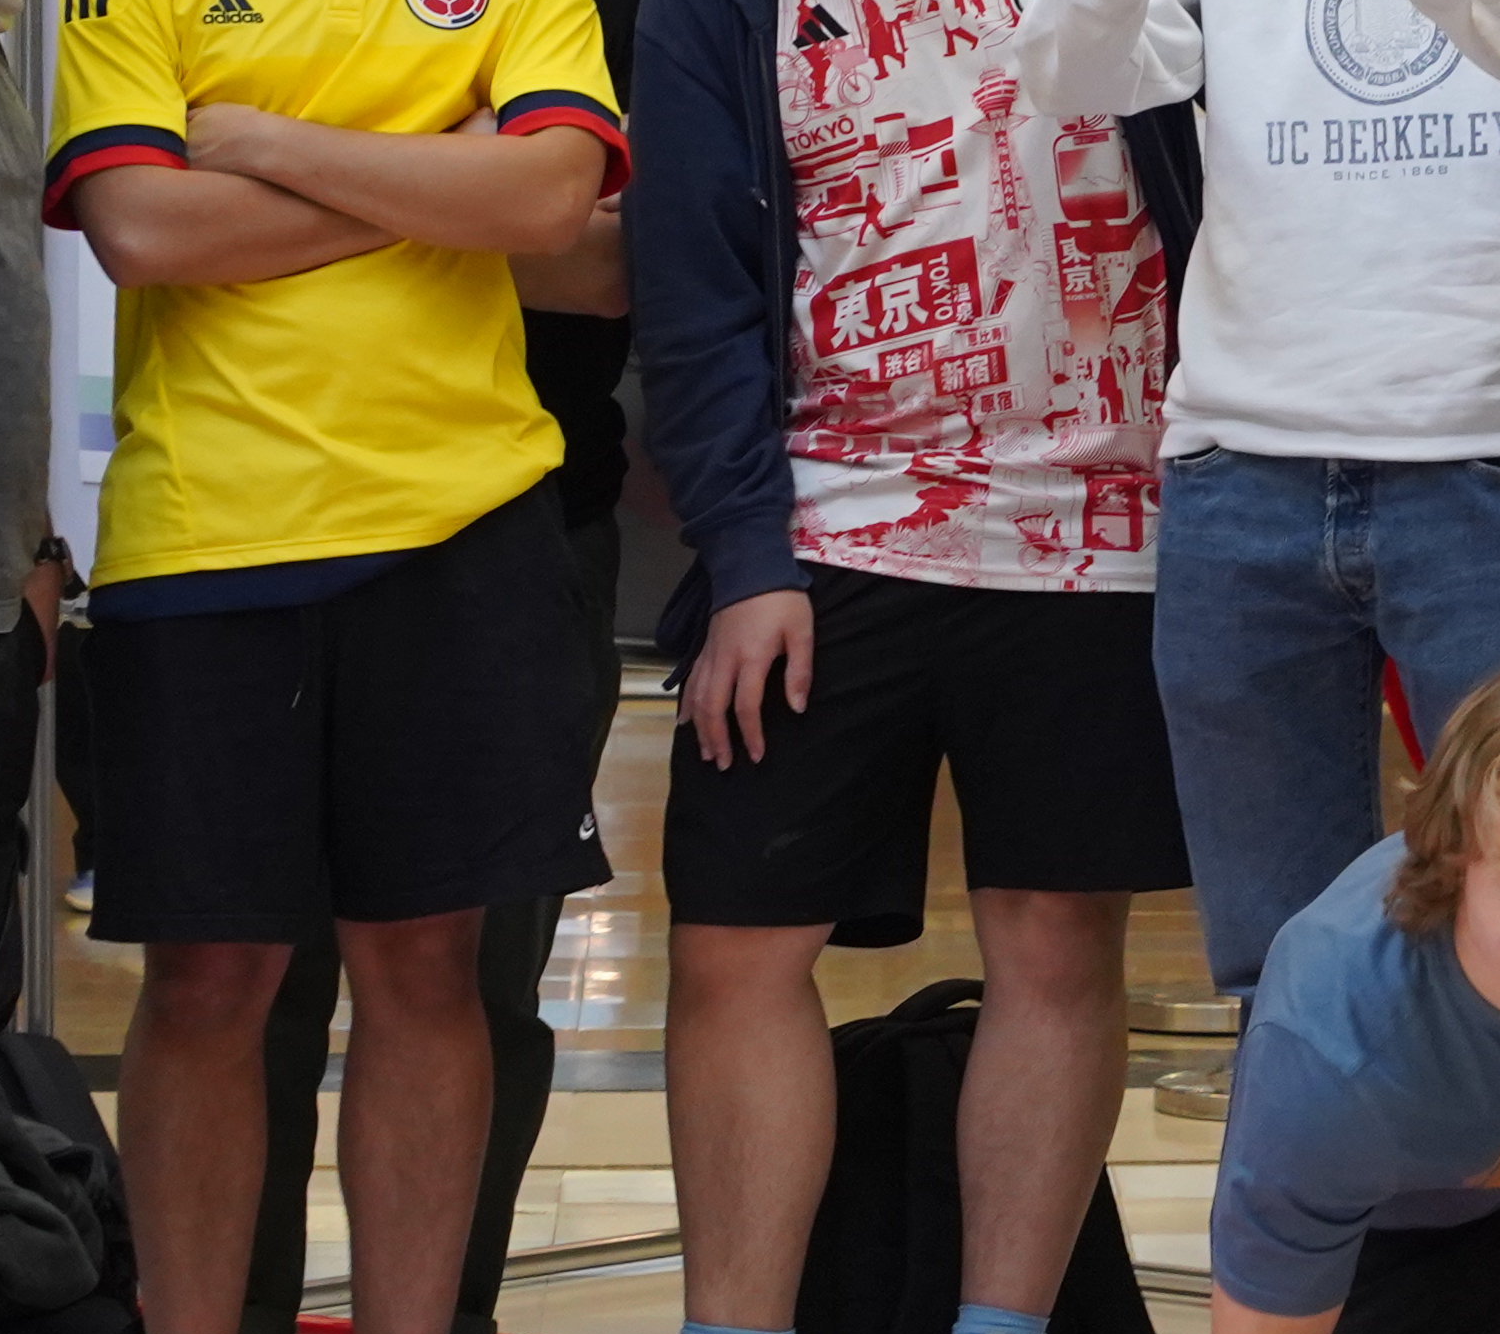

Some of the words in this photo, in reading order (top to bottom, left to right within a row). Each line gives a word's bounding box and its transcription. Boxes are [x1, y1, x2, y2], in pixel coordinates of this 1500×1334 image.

[202, 9, 264, 24] adidas
[1266, 120, 1309, 165] UC
[1000, 160, 1018, 219] OSAKA
[1333, 169, 1390, 181] SINCE
[1402, 165, 1449, 177] 1868
[927, 251, 954, 322] TOKYO
[1058, 235, 1096, 293] 東京
[827, 260, 930, 351] 東京
[939, 352, 991, 393] 新宿
